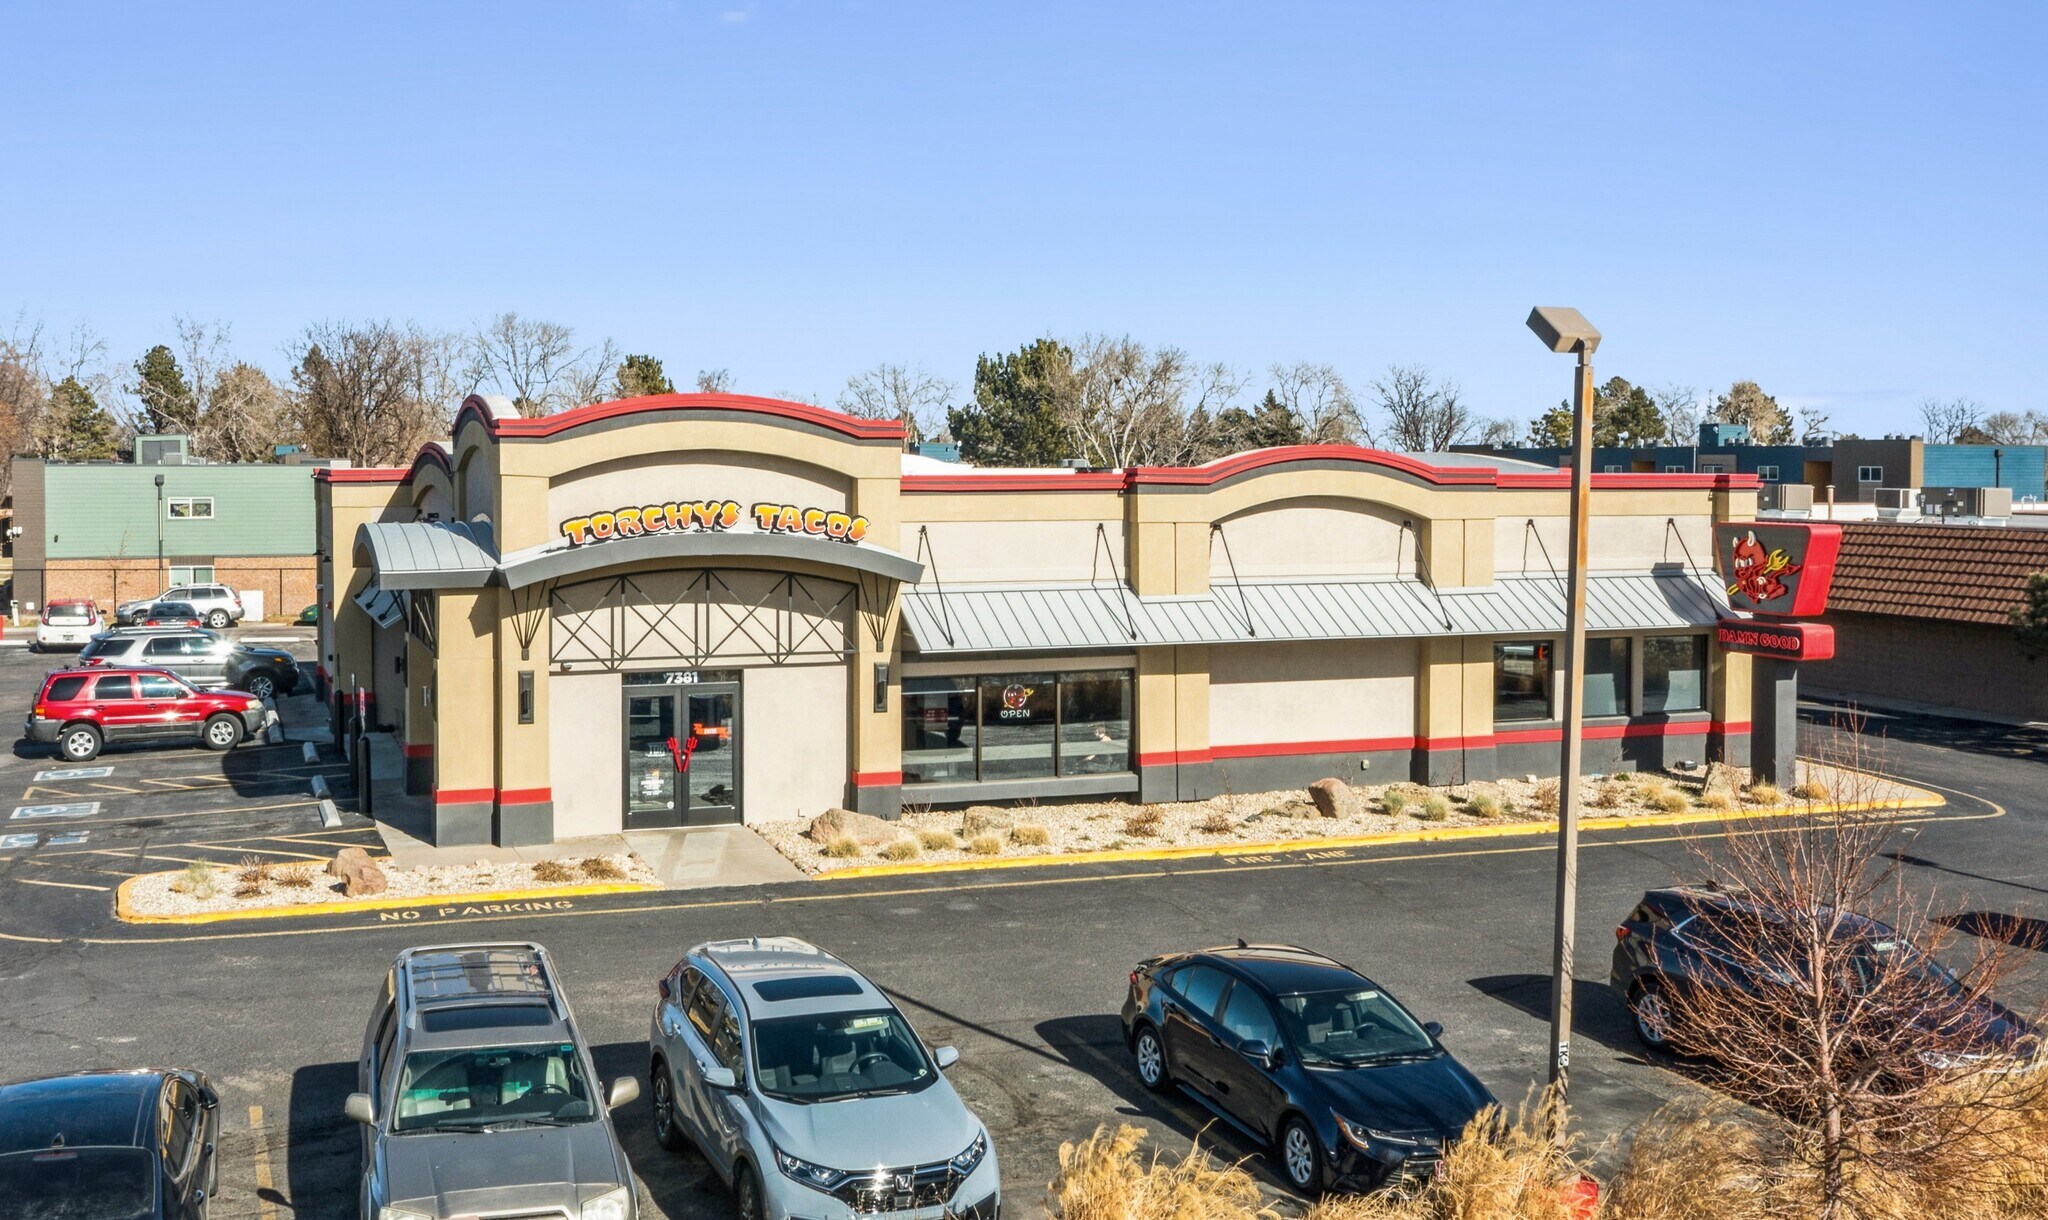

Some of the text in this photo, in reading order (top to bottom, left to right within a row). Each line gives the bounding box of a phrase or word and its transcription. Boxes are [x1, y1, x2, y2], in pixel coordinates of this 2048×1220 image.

[750, 503, 871, 543] TACOS
[1719, 628, 1800, 650] DAMN GOOD
[666, 671, 698, 684] 7381
[1000, 709, 1030, 718] OPEN
[379, 901, 574, 921] NO PARKING
